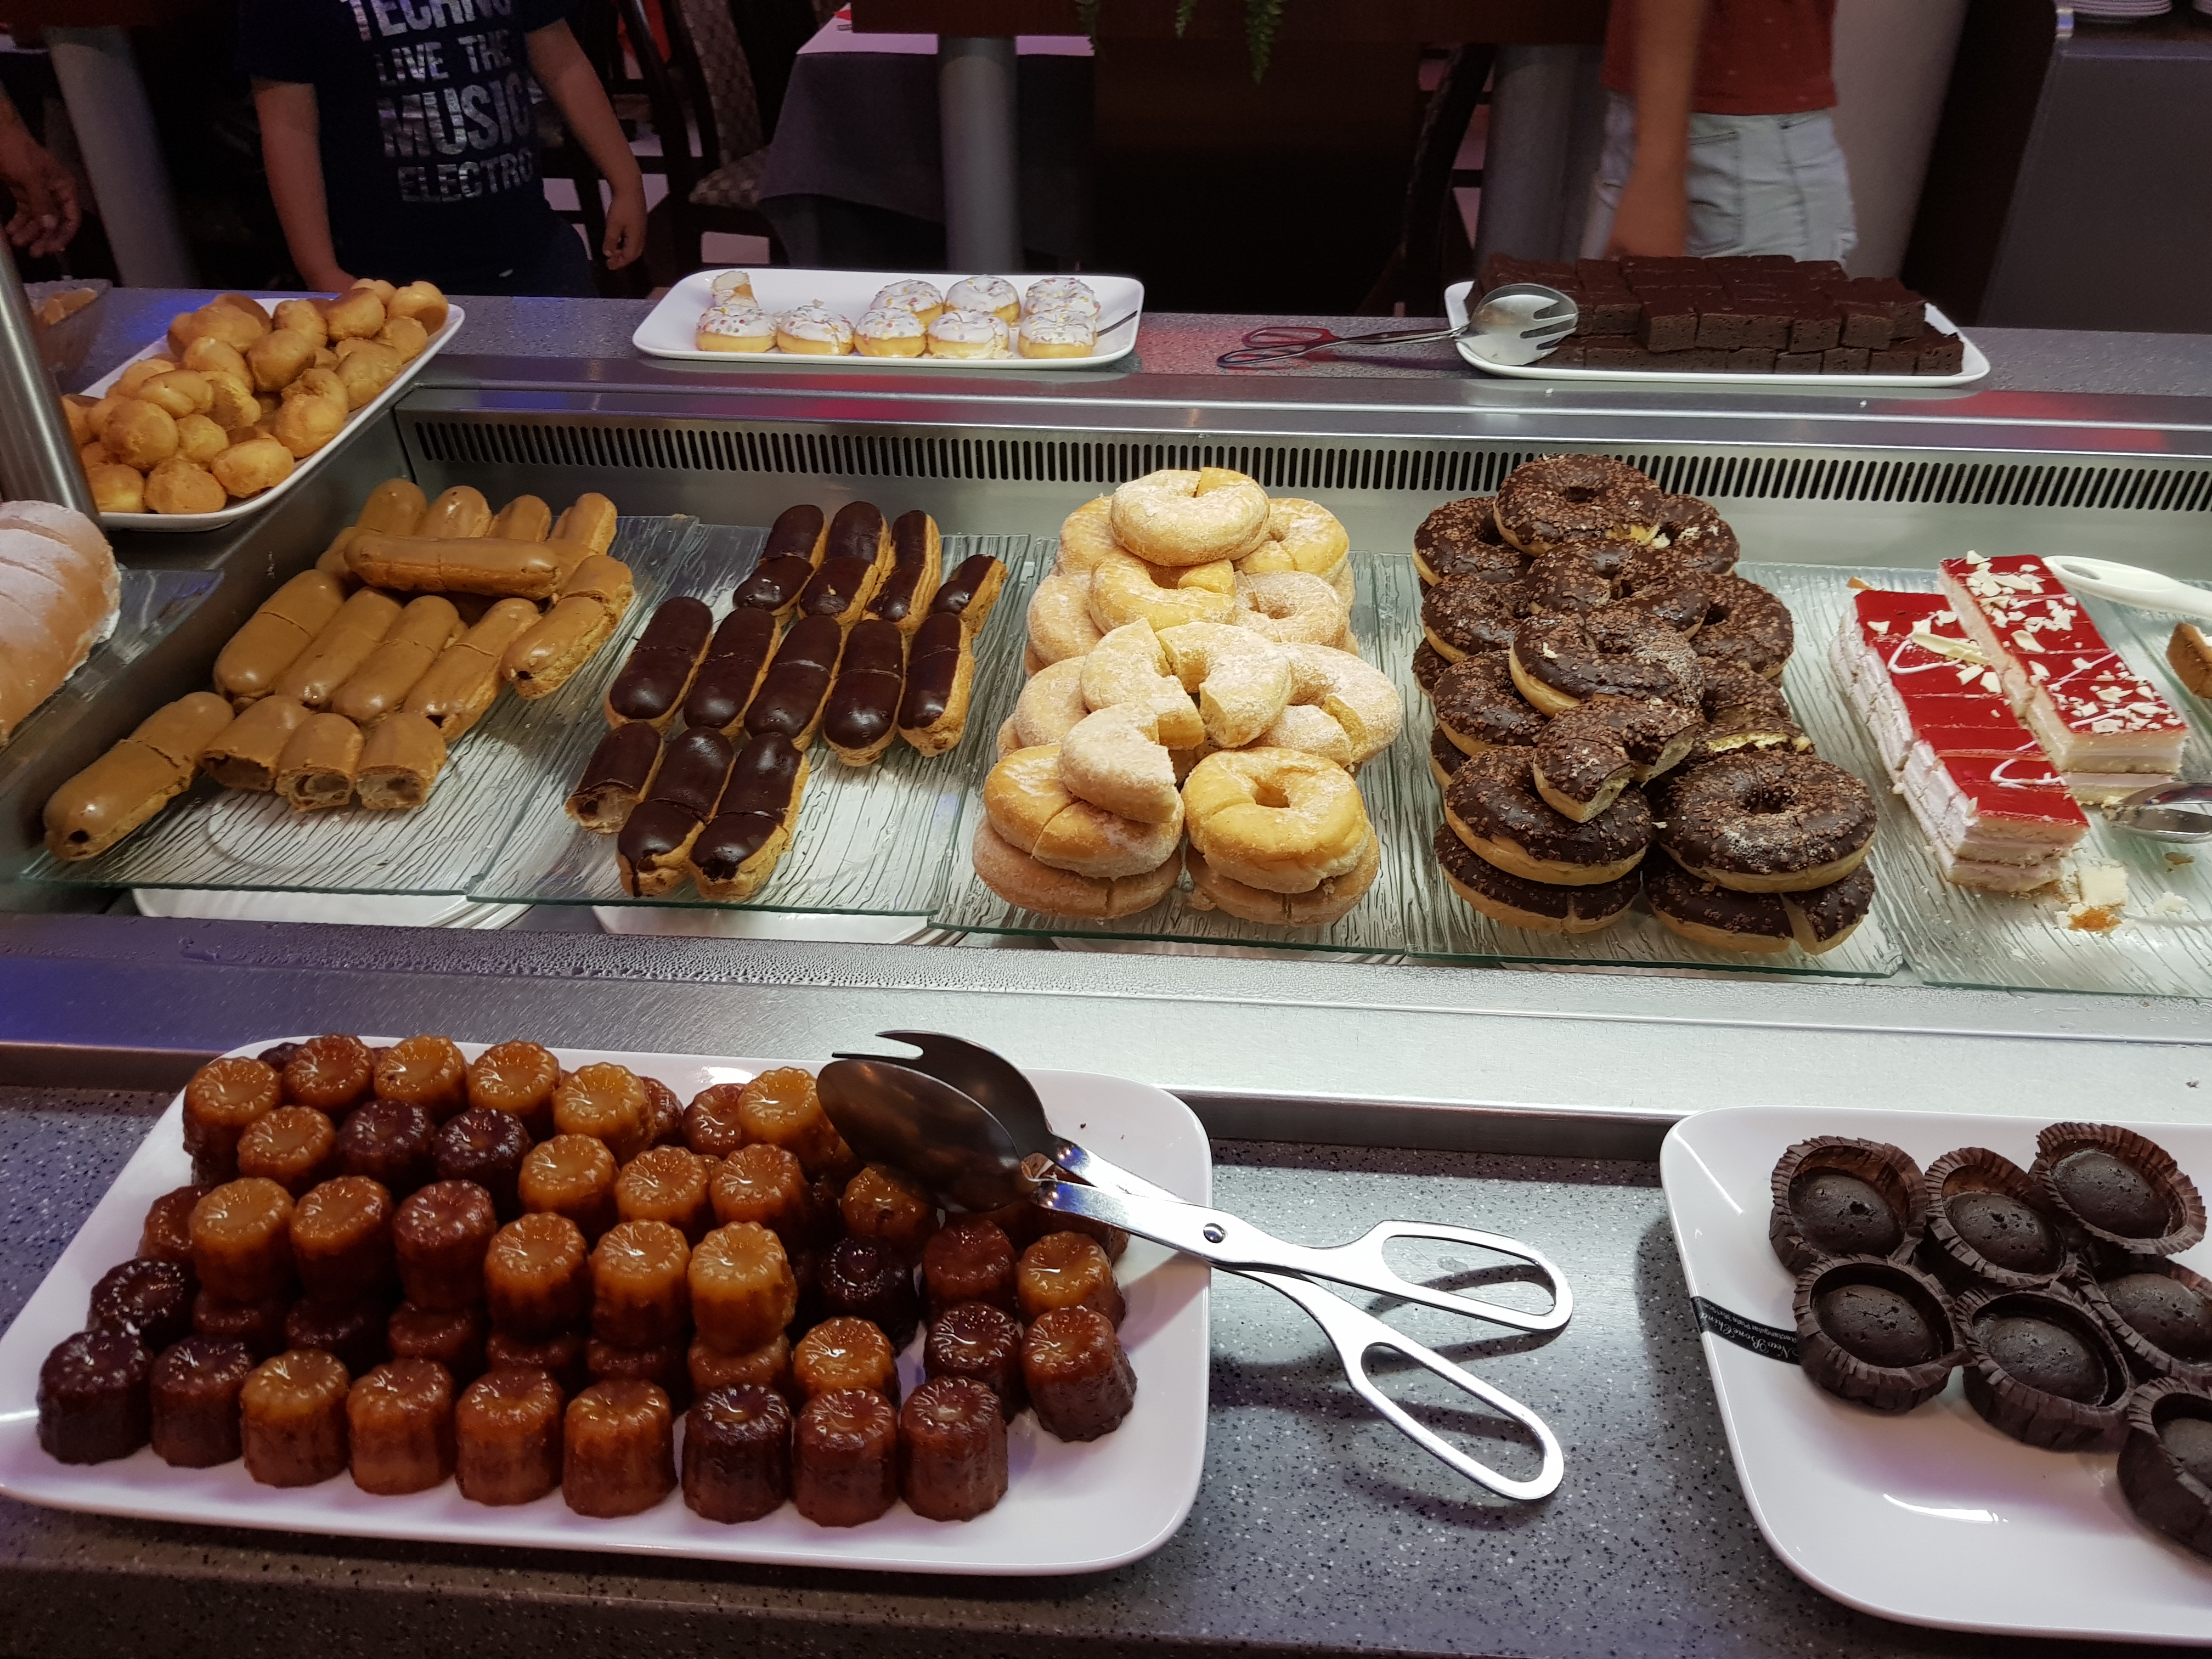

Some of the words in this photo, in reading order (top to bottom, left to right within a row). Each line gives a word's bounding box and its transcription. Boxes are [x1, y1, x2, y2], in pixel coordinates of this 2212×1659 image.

[374, 42, 449, 87] LIVE
[458, 29, 511, 74] THE
[377, 72, 529, 158] MUSIC
[397, 149, 534, 202] ELECTRO
[1699, 1312, 1735, 1338] China
[1733, 1317, 1751, 1329] Plate
[1752, 1325, 1798, 1343] Rectangular
[1733, 1328, 1769, 1353] Bone
[1767, 1342, 1799, 1358] New
